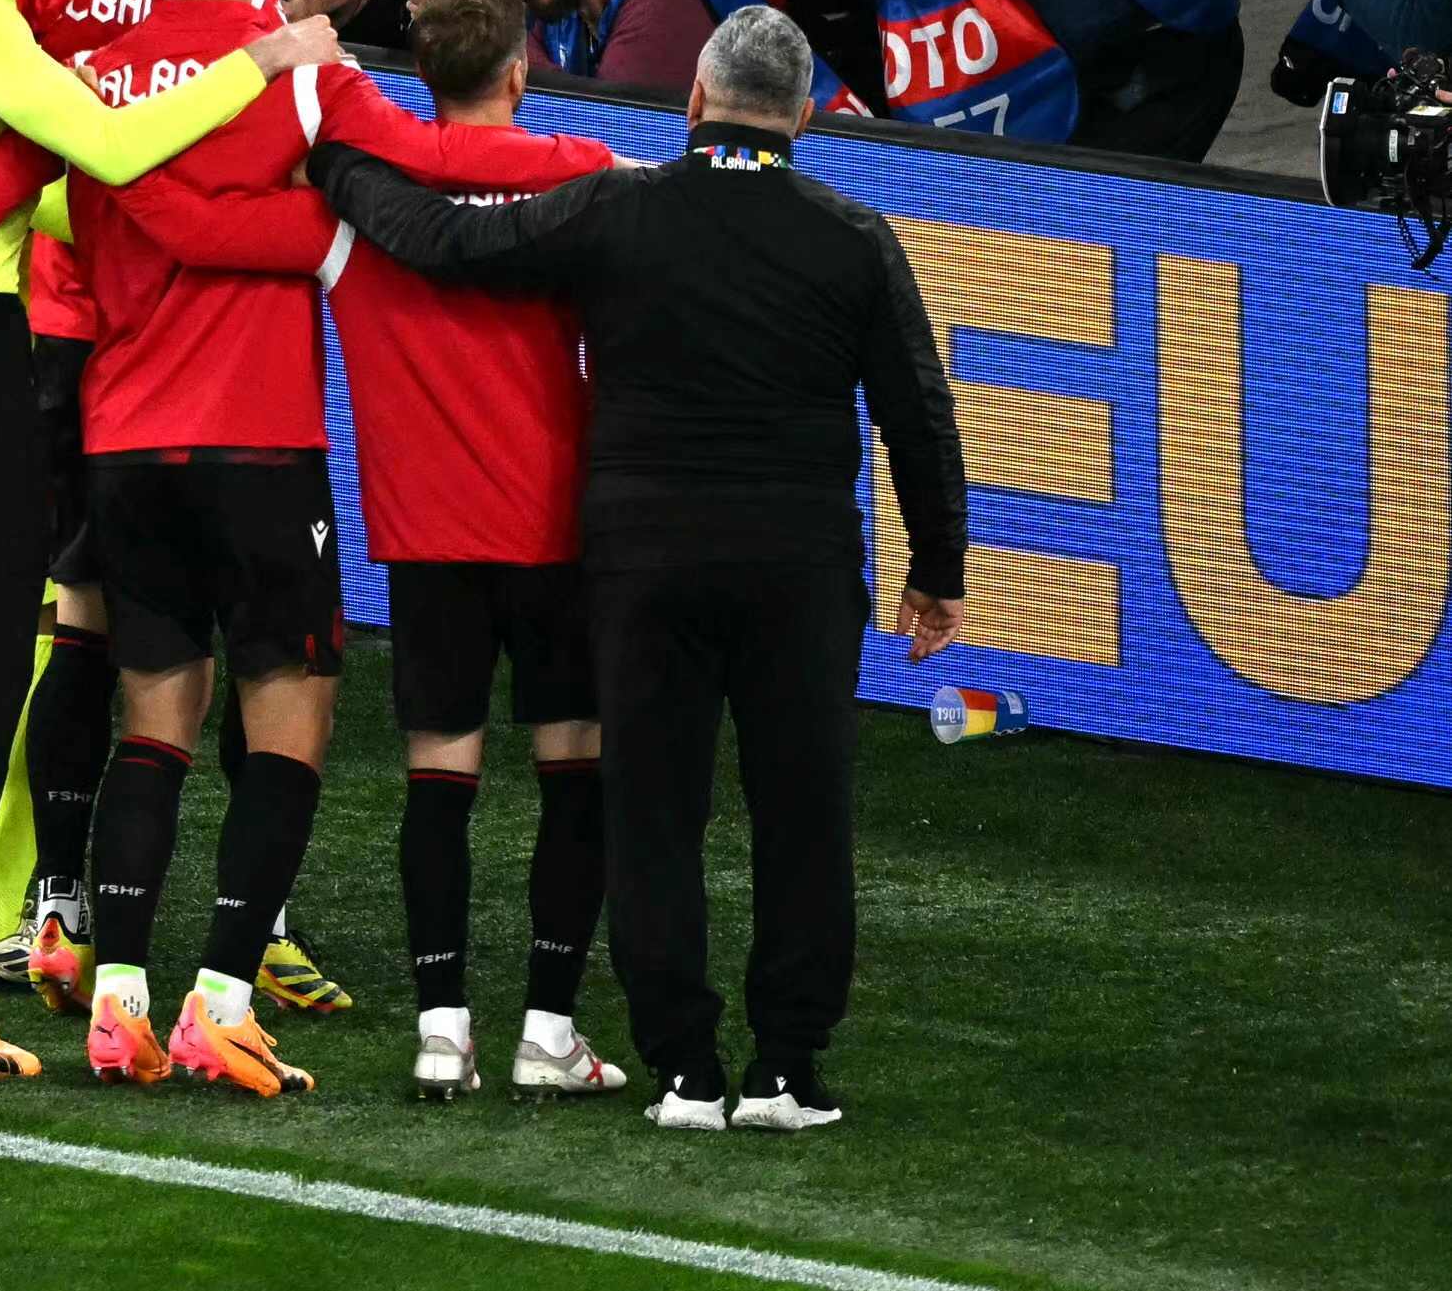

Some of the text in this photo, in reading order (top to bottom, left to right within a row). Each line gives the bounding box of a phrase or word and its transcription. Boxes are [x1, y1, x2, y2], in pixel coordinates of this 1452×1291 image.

[933, 93, 1011, 137] 7
[711, 156, 762, 172] ALBANIA
[98, 883, 146, 897] FSHF
[533, 939, 575, 954] FSHF
[415, 951, 457, 967] FSHF
